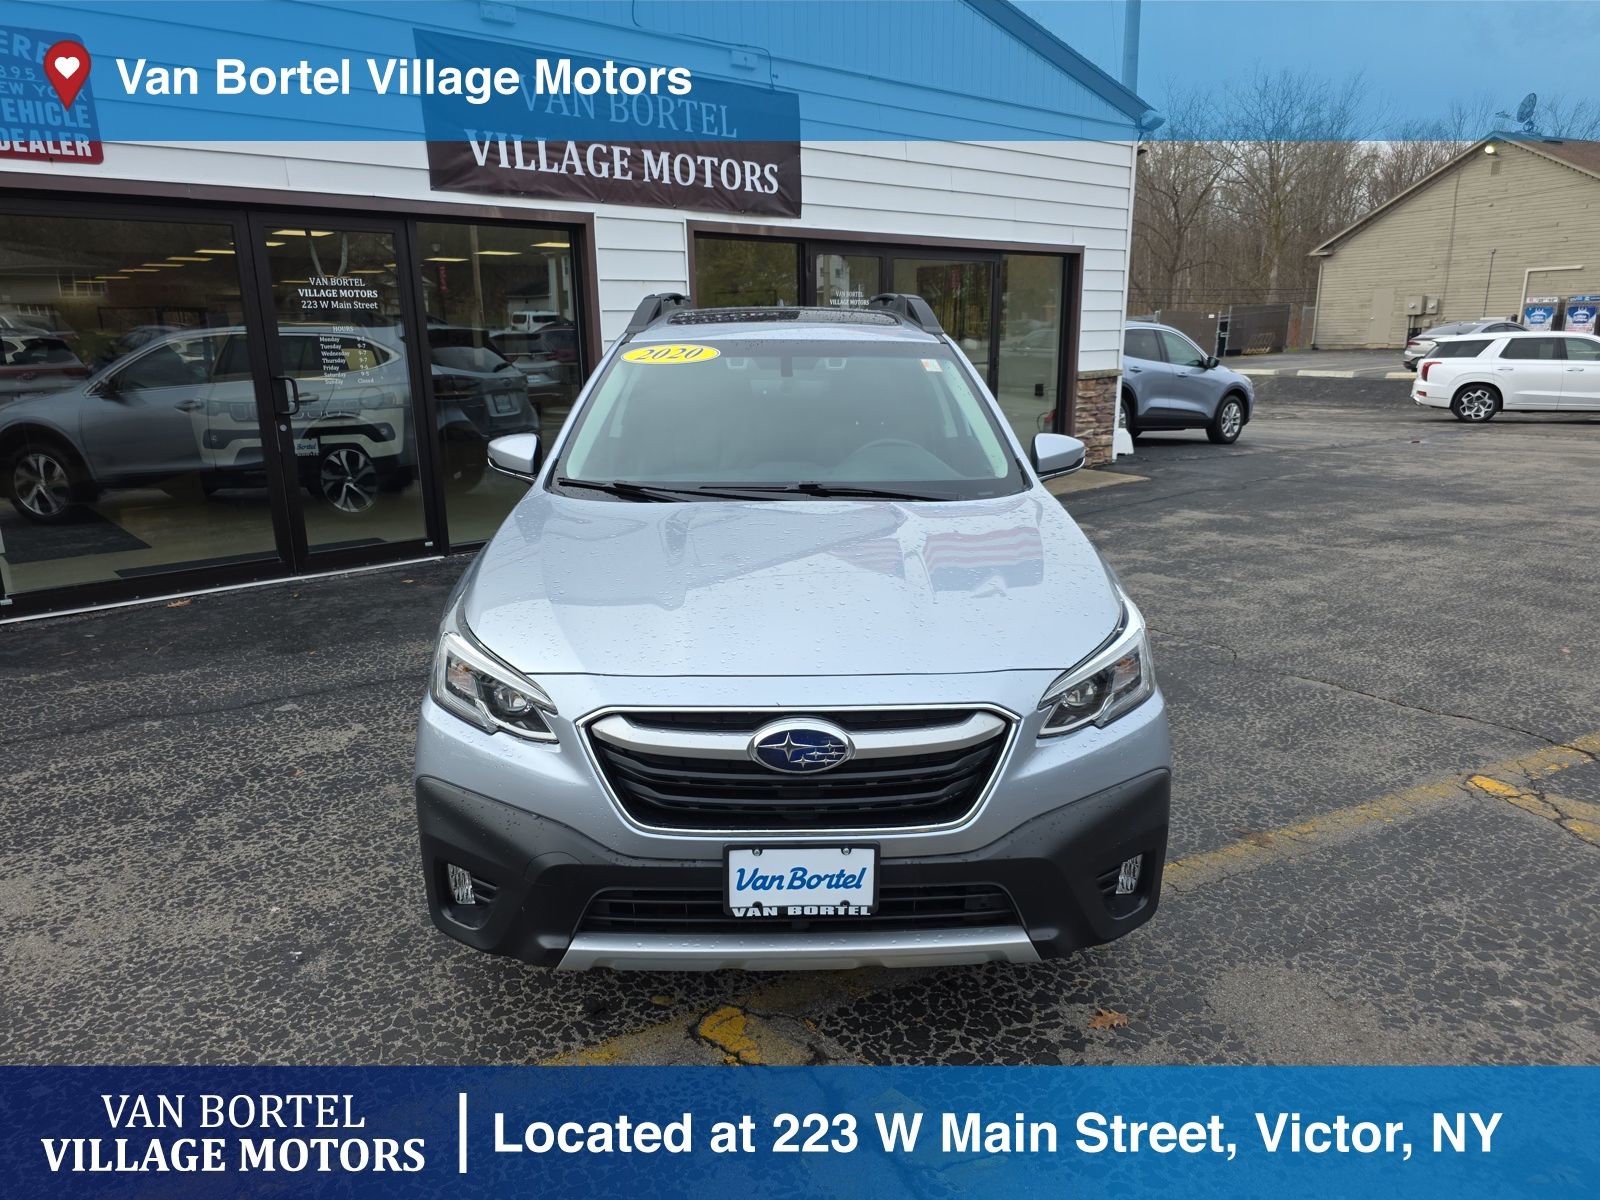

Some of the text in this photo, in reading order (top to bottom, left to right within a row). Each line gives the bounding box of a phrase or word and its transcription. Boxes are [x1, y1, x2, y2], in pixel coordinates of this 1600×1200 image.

[608, 89, 738, 139] BORTEL
[0, 128, 92, 157] DEALER
[463, 128, 779, 194] VILLAGE MOTORS
[309, 277, 365, 286] VAN BORTEL
[298, 288, 378, 298] VILLAGE MOTORS
[301, 300, 378, 309] 223 W Main Street
[634, 347, 704, 361] 2020
[736, 866, 867, 891] Van Bortel
[732, 906, 871, 917] VAN BORTEL
